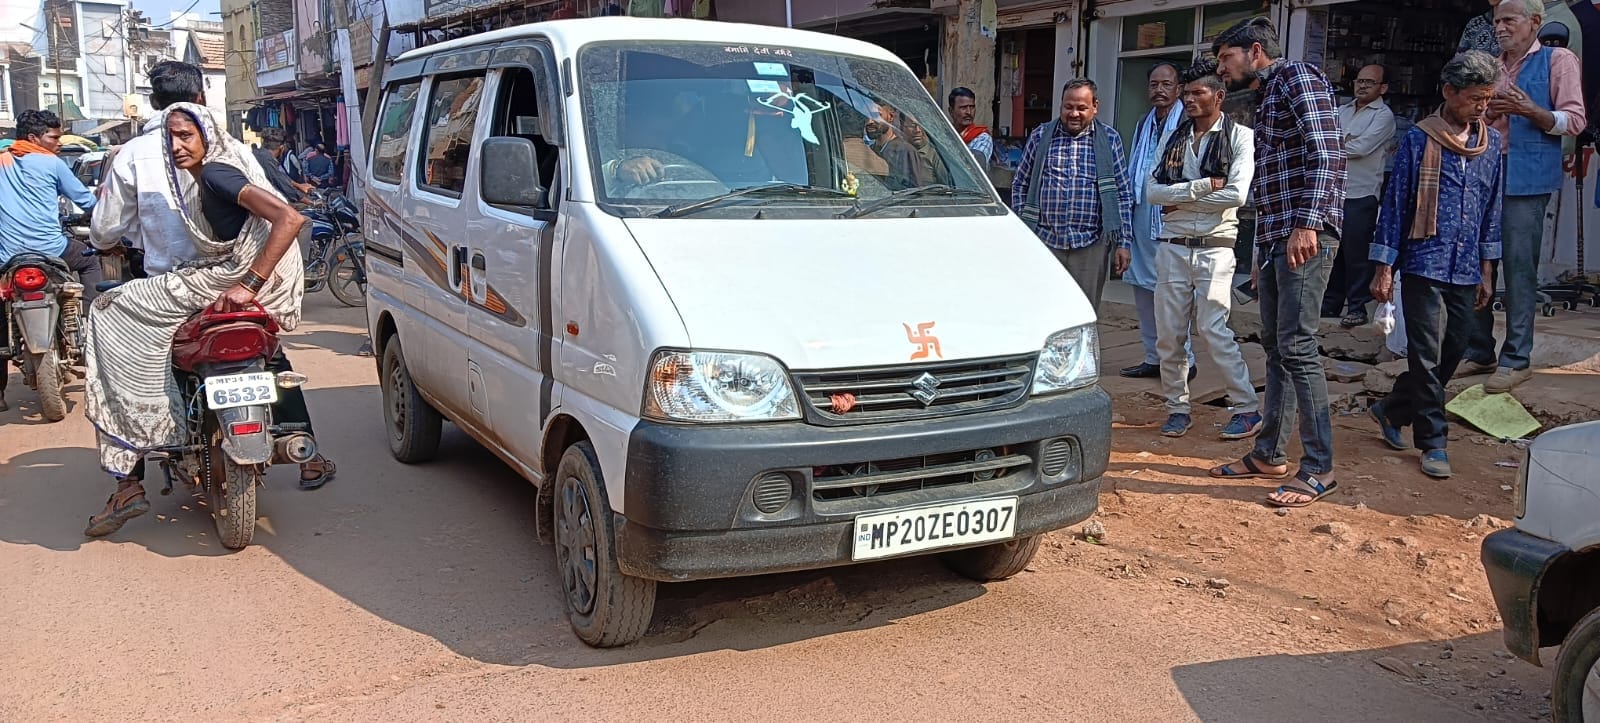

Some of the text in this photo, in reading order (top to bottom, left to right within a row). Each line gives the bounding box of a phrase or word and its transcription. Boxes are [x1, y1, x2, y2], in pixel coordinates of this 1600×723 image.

[214, 386, 270, 404] 6532
[872, 507, 1013, 549] MP20ZE0307
[858, 533, 871, 542] IND
